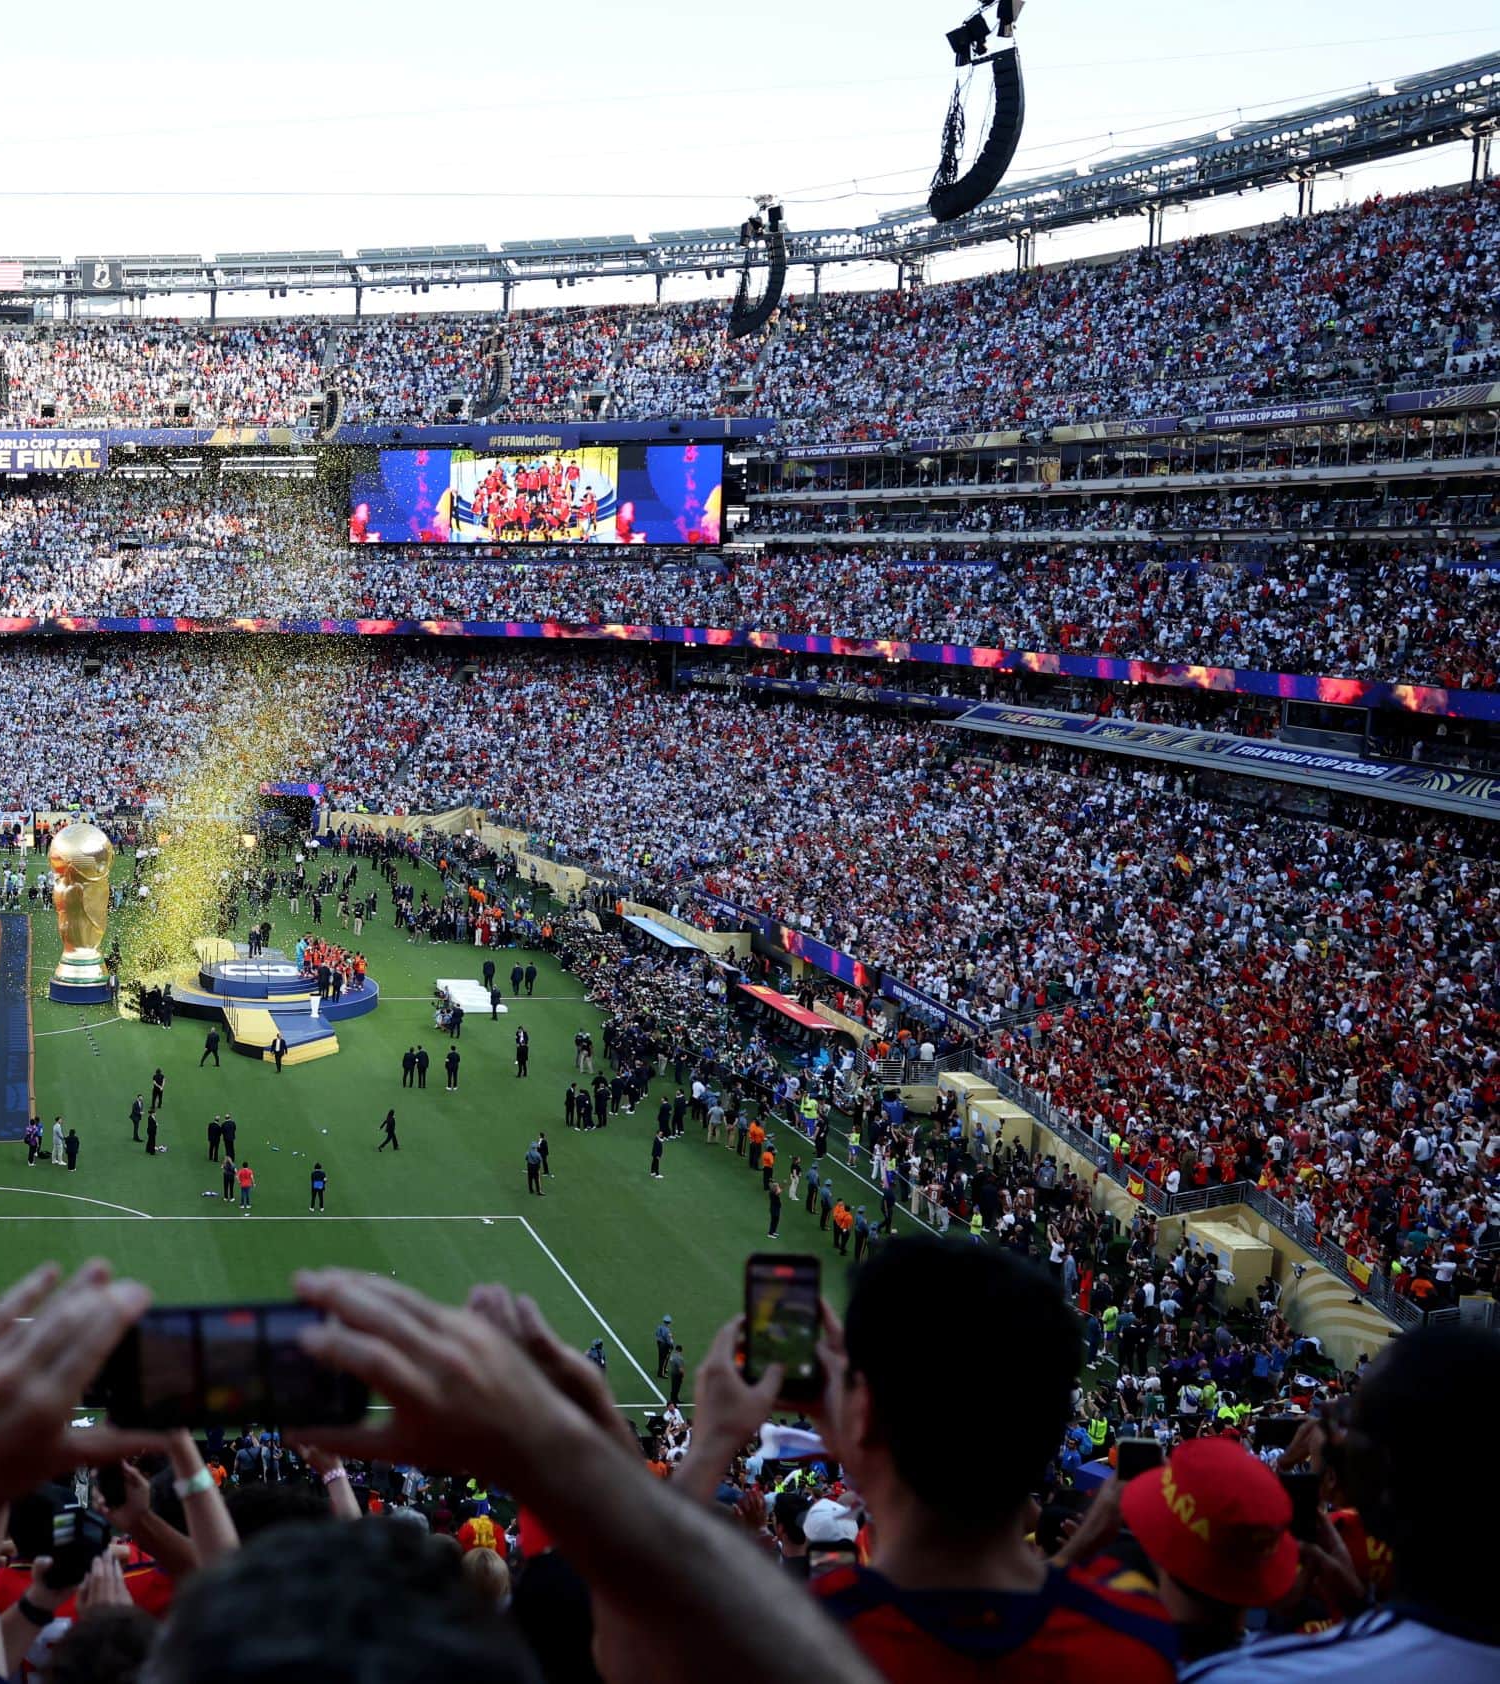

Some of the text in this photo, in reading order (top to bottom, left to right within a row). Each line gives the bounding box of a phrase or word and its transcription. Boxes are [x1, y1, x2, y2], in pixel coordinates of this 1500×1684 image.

[1214, 404, 1345, 425] FIFA WORLD CUP 2026 THE FINAL
[30, 438, 55, 450] CUP
[56, 438, 100, 450] 2026
[489, 434, 562, 448] #FIFAWorldCup
[788, 444, 880, 457] NEW YORK NEW JERSEY
[17, 450, 100, 469] FINAL
[996, 711, 1066, 728] THE FINAL
[1234, 745, 1389, 777] FIFA WORLD CUP 2026
